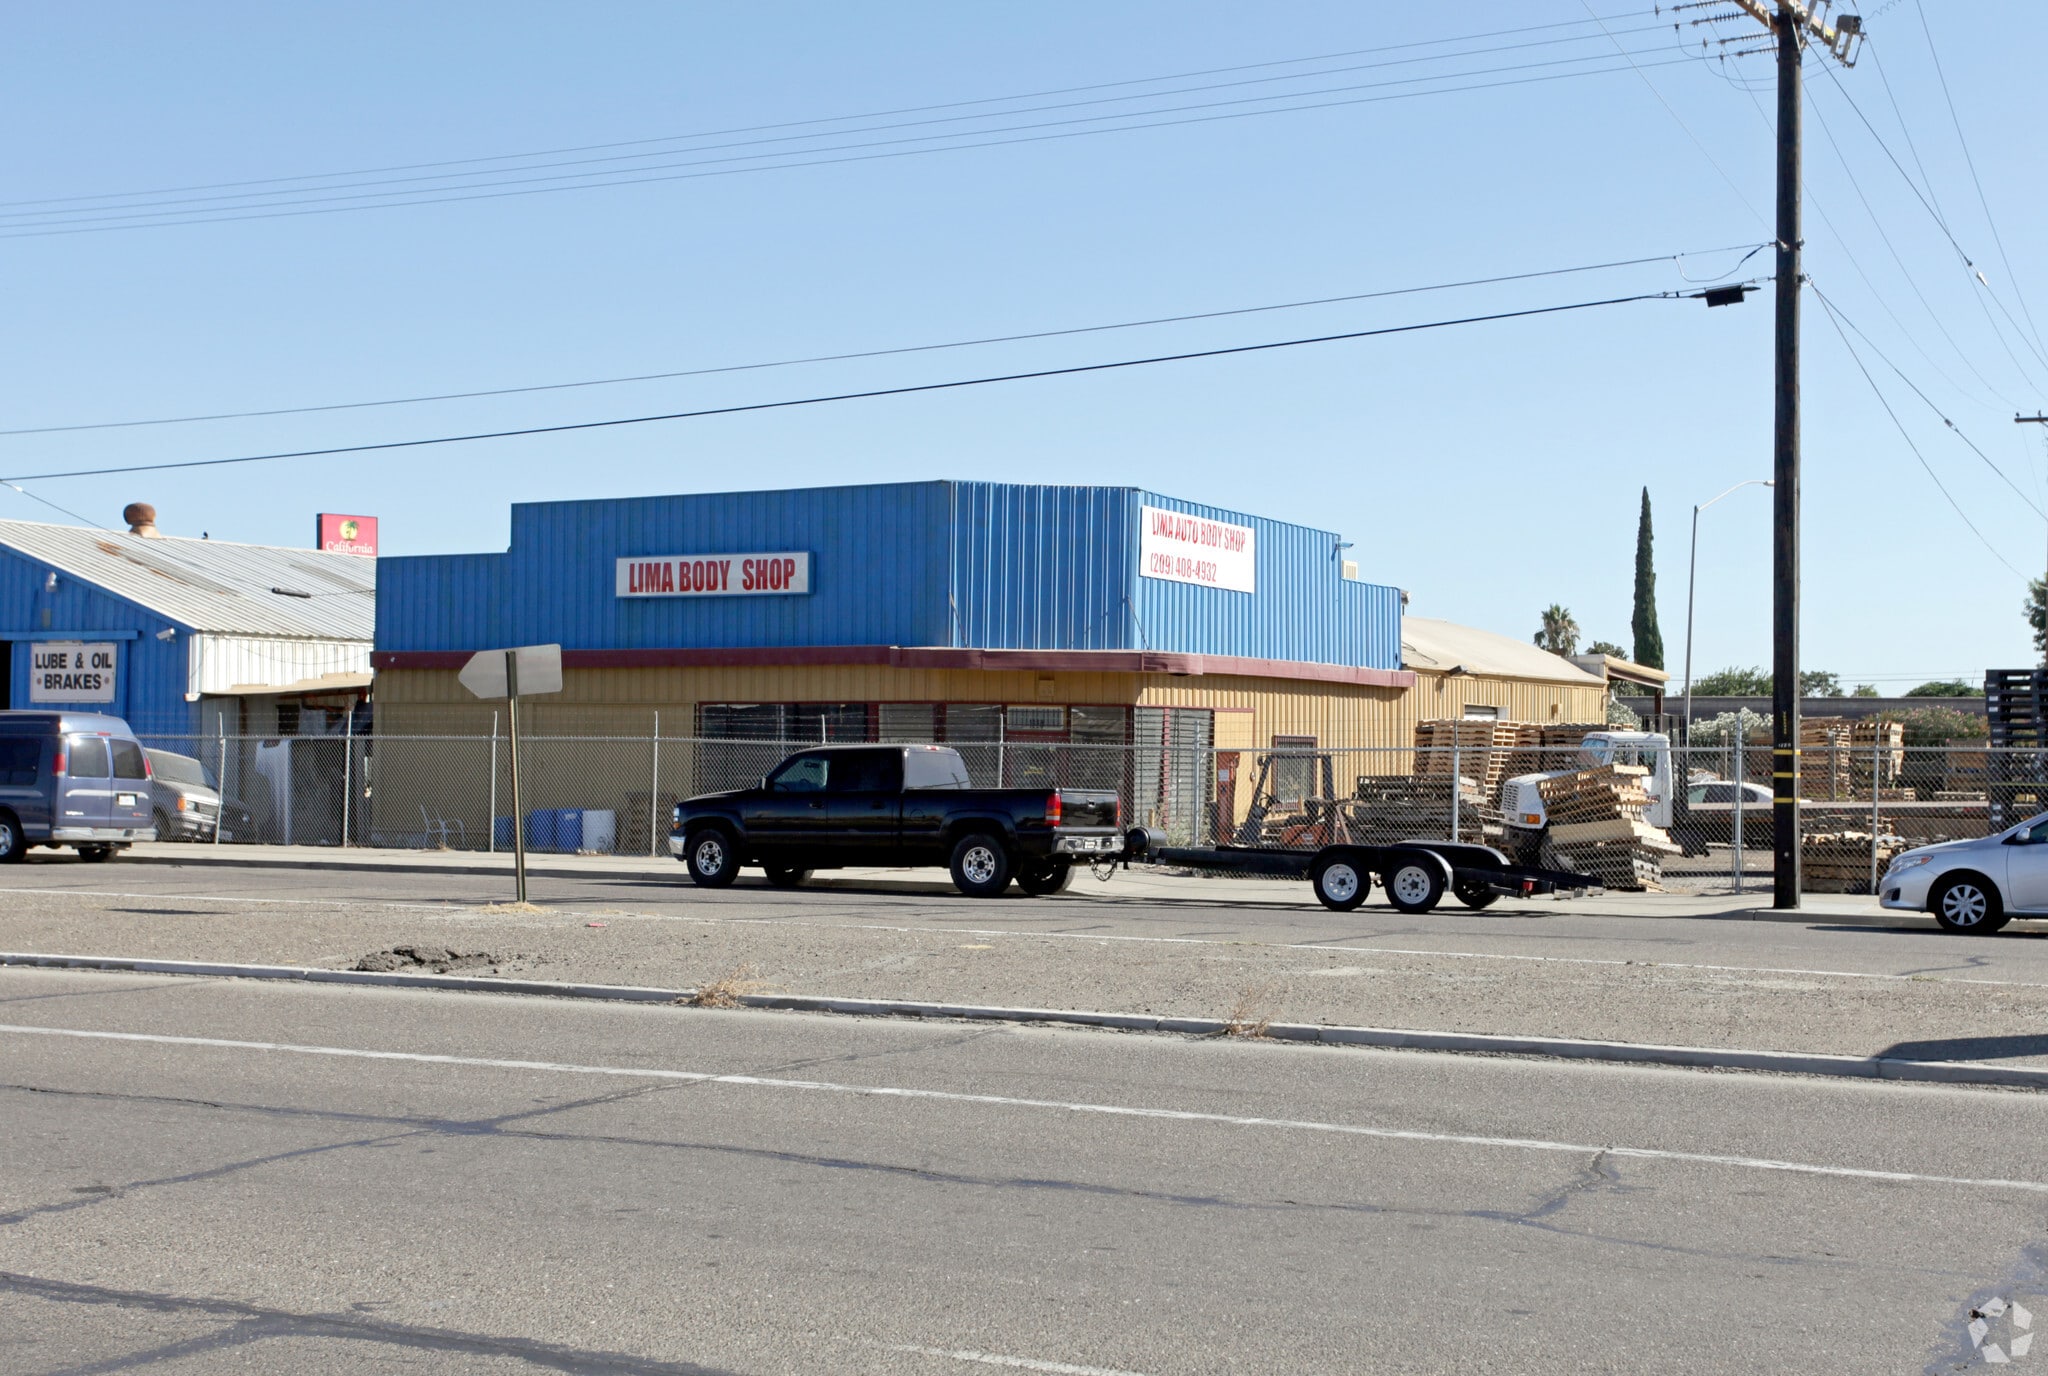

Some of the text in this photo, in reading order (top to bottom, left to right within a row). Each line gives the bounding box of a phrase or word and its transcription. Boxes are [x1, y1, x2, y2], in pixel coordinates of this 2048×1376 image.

[1152, 512, 1246, 552] LIMA AUTO BODY SHOP
[325, 540, 374, 554] California
[629, 558, 796, 593] LIMA BODY SHOP
[1151, 552, 1217, 582] (209) 408-4932
[35, 652, 112, 669] LUBE & OIL
[44, 673, 102, 689] BRAKES
